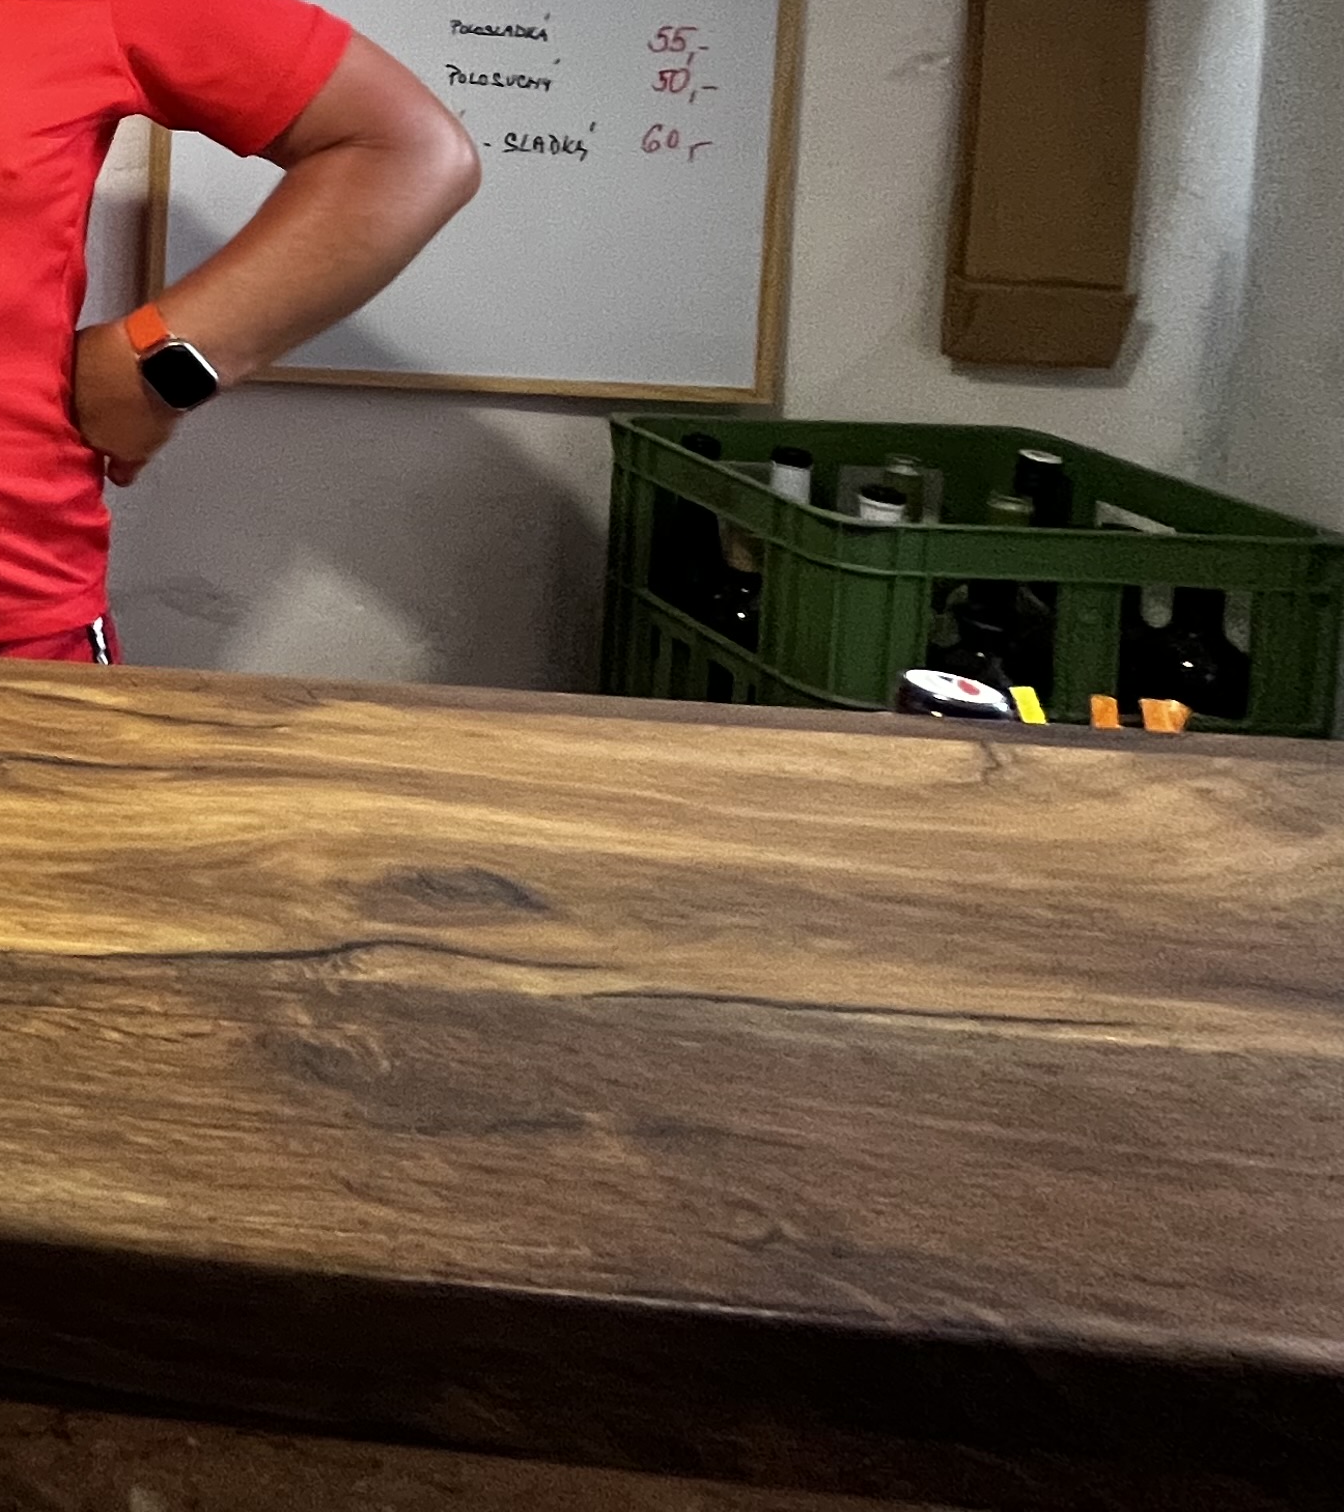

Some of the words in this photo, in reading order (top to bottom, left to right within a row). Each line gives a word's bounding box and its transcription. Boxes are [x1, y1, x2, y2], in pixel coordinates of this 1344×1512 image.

[647, 26, 710, 66] 55,-
[445, 58, 561, 93] POLOSUCHÝ
[651, 68, 718, 104] 50,-
